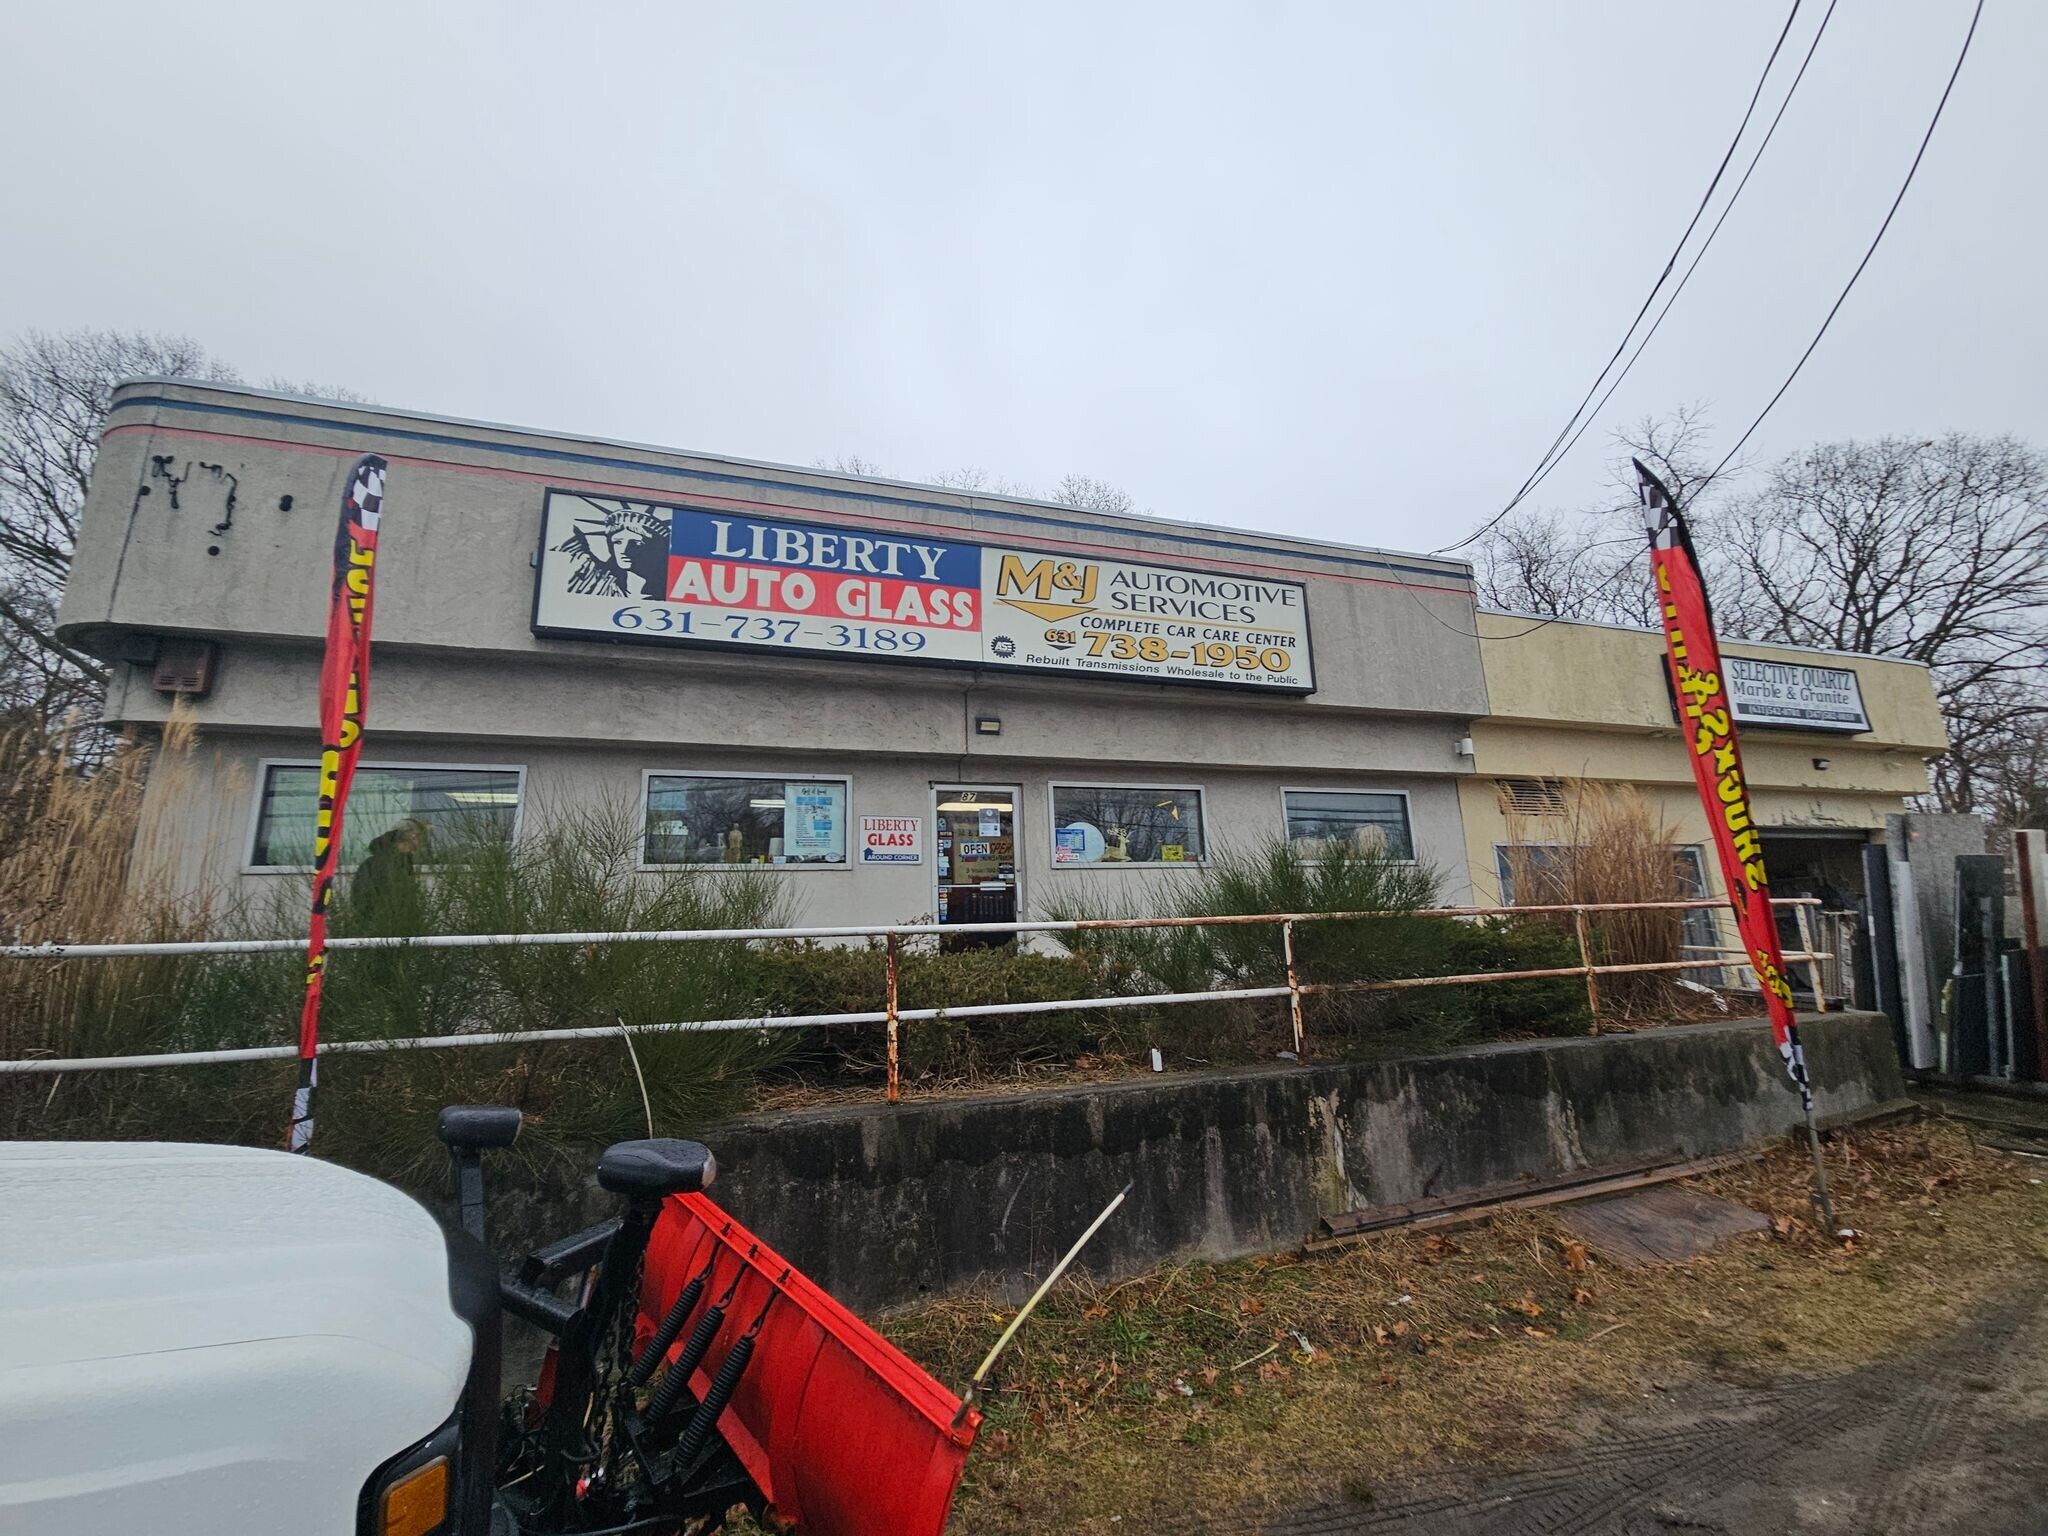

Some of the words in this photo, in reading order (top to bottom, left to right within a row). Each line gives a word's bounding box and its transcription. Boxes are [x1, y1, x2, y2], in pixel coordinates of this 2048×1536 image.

[710, 519, 948, 580] LIBERTY
[669, 561, 817, 612] AUTO
[835, 578, 975, 628] GLASS
[996, 554, 1100, 605] M&J
[1110, 569, 1298, 608] AUTOMOTIVE
[1111, 591, 1257, 625] SERVICES
[611, 605, 928, 654] 631-737-3189
[1079, 616, 1161, 636] COMPLETE
[1166, 624, 1197, 640] CAR
[1203, 628, 1240, 643] CARE
[1245, 632, 1298, 649] CENTER
[1044, 628, 1077, 645] 631
[1082, 630, 1292, 674] 738-1950
[1026, 653, 1071, 668] Rebuilt
[1076, 657, 1161, 674] Transmissions
[1166, 665, 1226, 680] Wholesale
[1229, 670, 1241, 681] to
[1245, 671, 1263, 683] the
[1267, 673, 1299, 686] Public
[1731, 661, 1799, 686] SELECTIVE
[1802, 668, 1850, 691] QUARTZ
[1733, 681, 1782, 699] Marble
[1786, 686, 1798, 700] &
[1800, 687, 1850, 705] Granite
[961, 792, 977, 801] 87
[864, 818, 918, 831] LIBERTY
[867, 833, 913, 846] GLASS
[963, 844, 988, 855] OPEN
